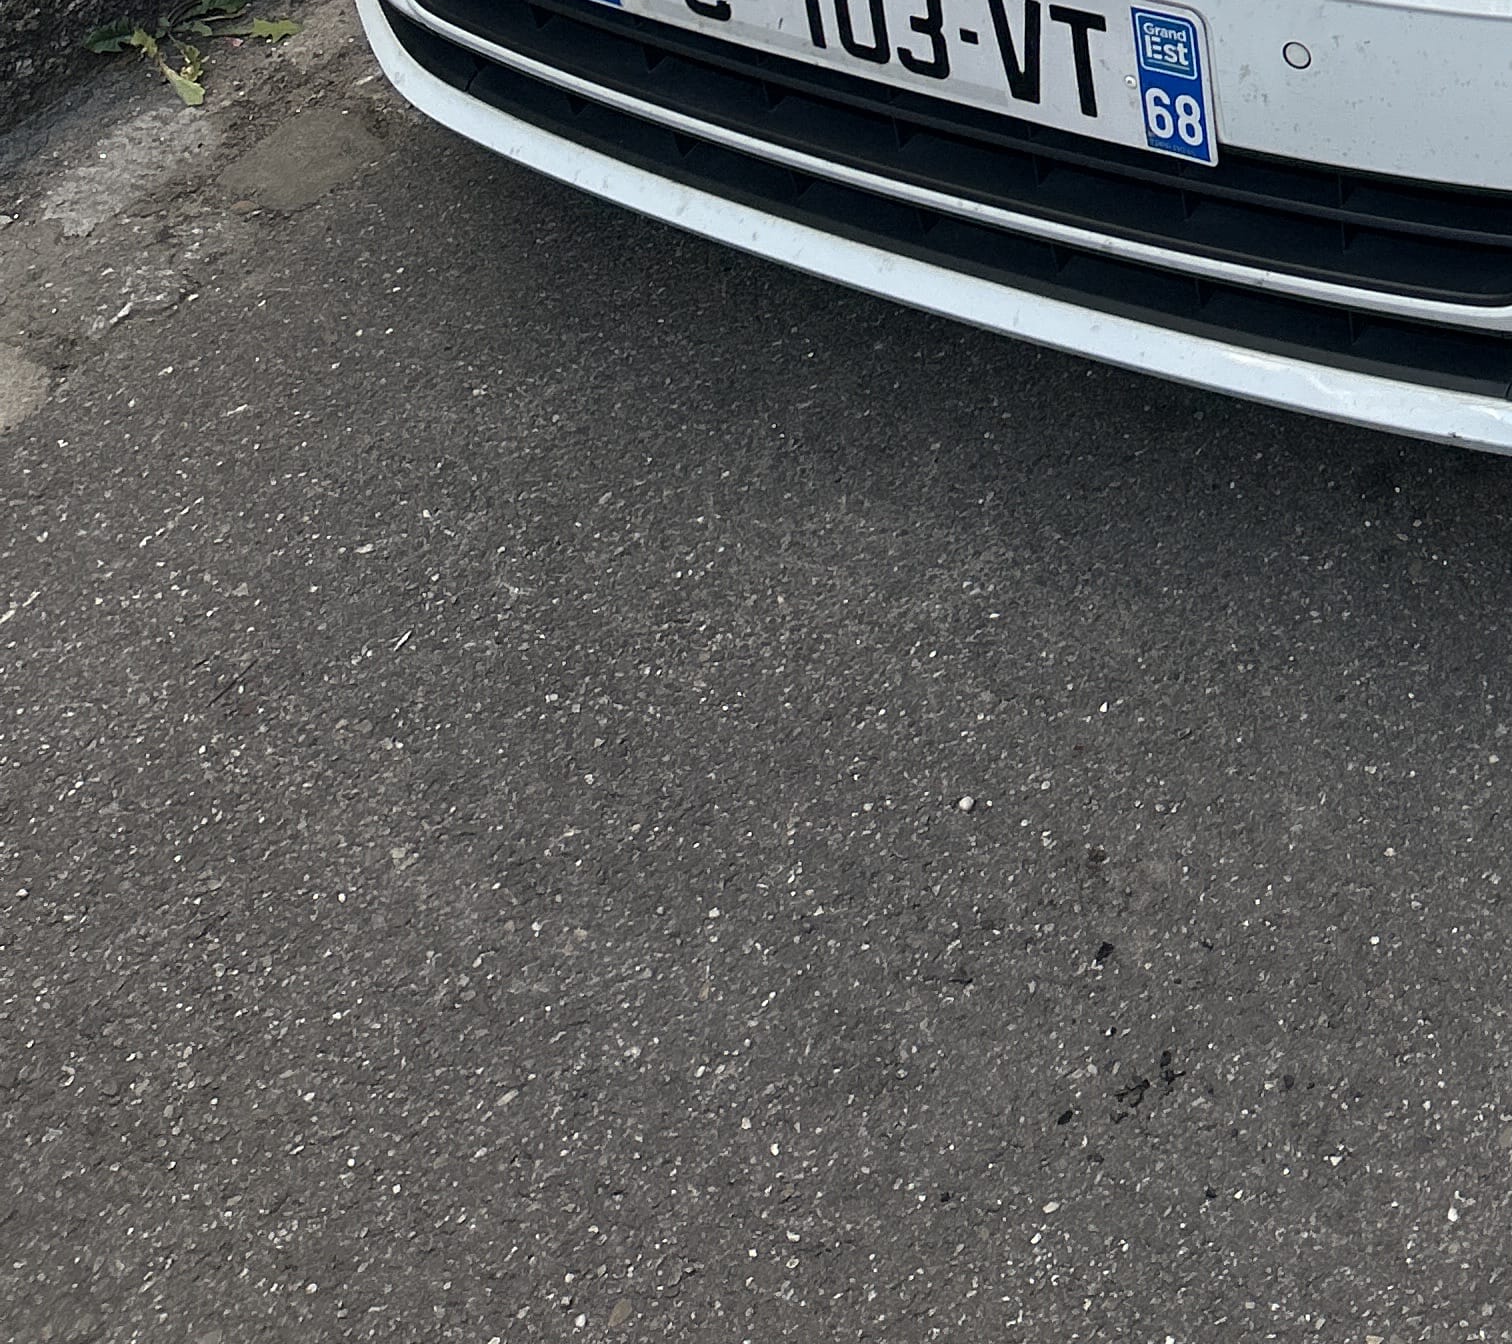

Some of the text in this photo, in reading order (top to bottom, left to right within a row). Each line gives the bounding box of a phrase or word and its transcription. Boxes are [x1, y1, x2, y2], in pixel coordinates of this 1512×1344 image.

[1142, 22, 1187, 42] Grand
[1144, 34, 1189, 66] Est
[1145, 87, 1203, 146] 68
